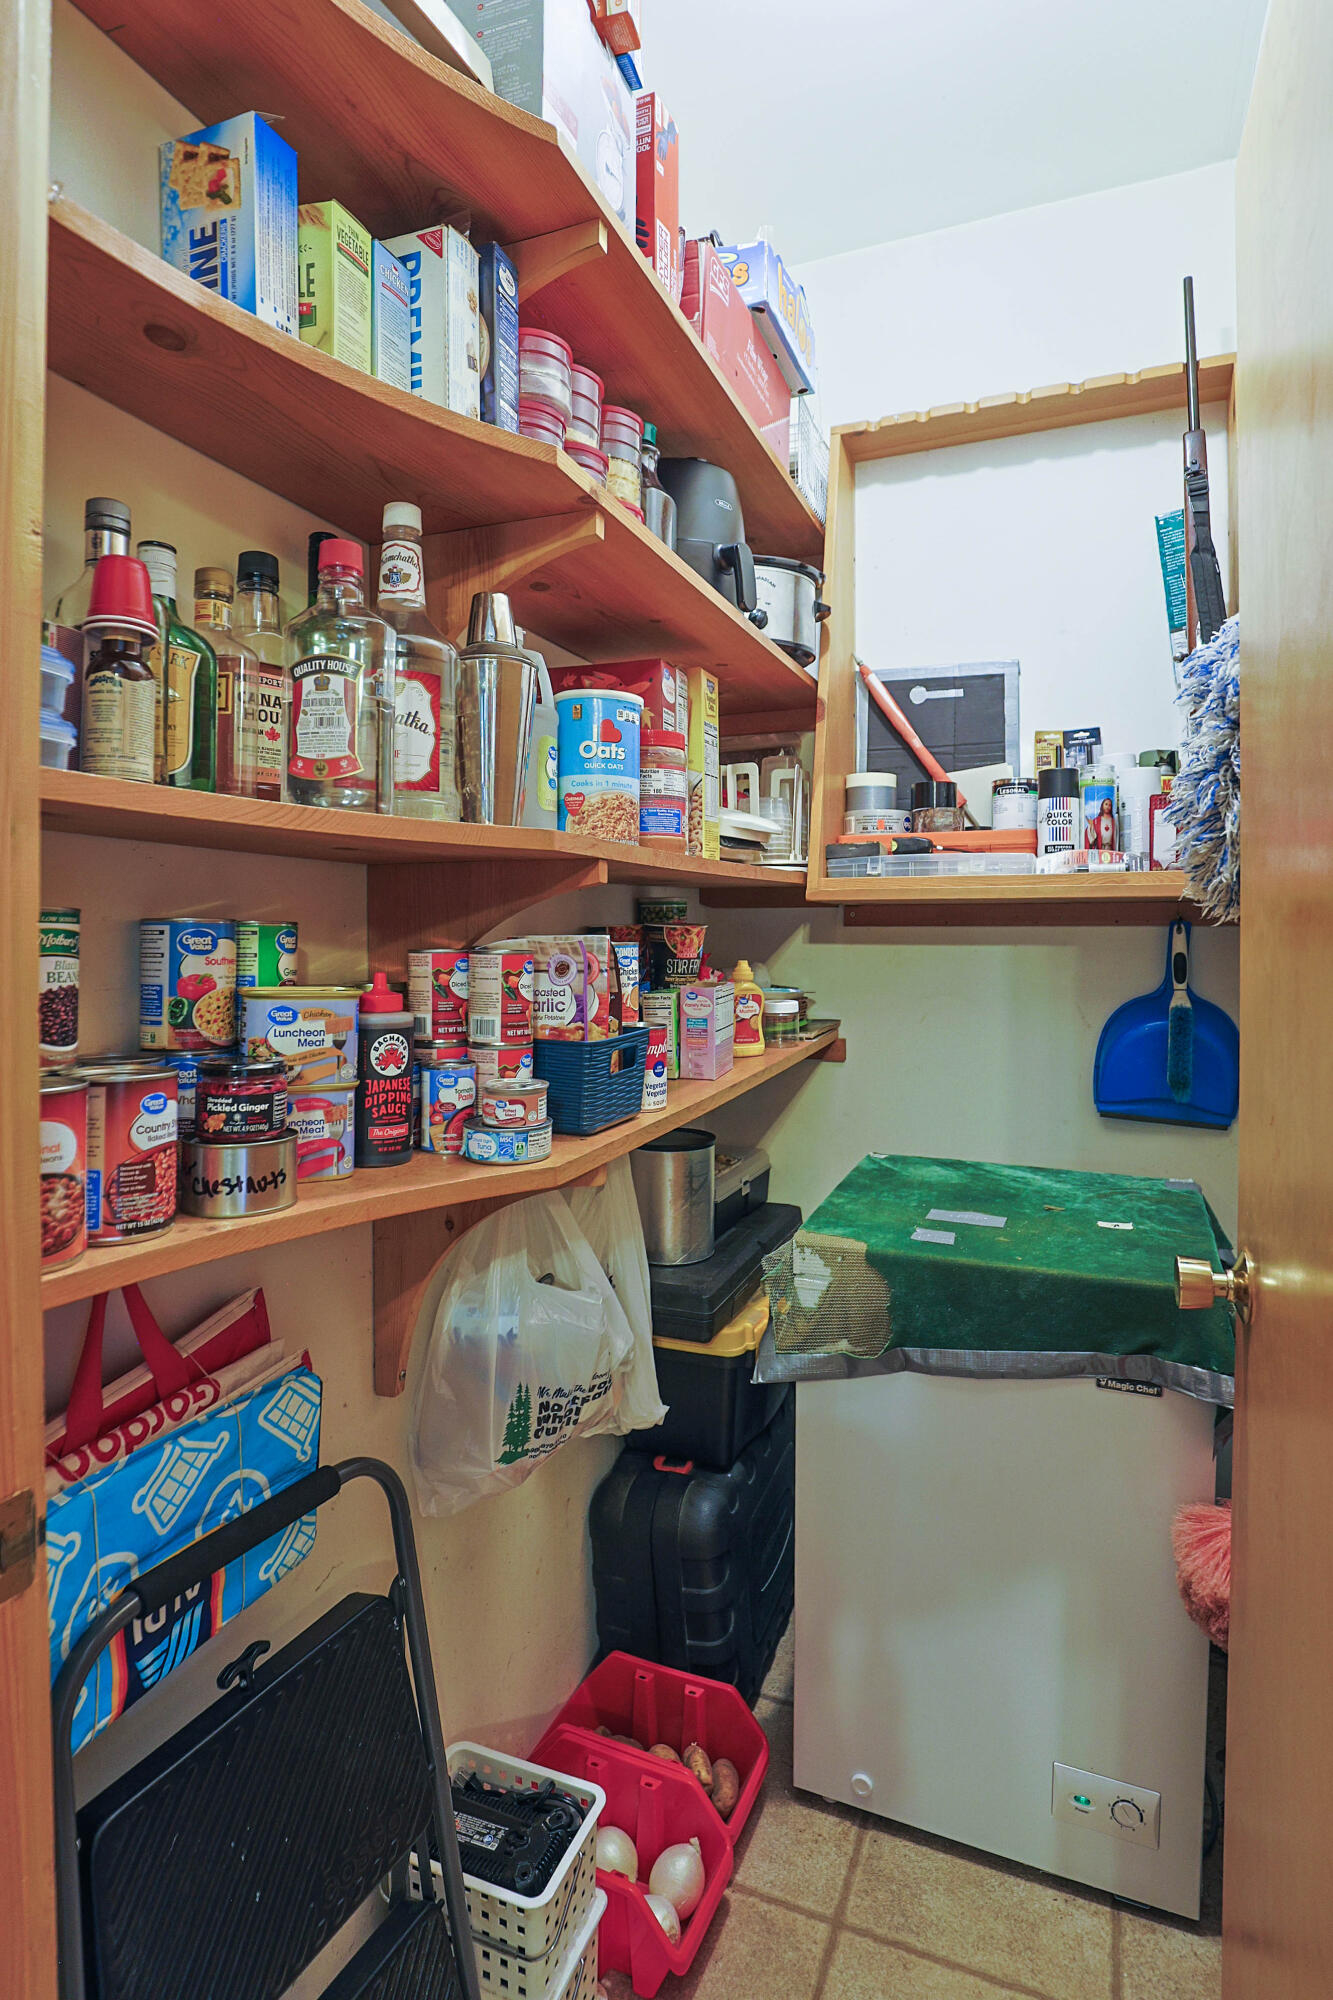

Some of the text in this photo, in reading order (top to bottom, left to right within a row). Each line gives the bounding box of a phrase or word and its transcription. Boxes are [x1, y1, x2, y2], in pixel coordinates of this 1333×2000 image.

[336, 223, 369, 267] VEGETABLE
[380, 263, 409, 297] CHICKEN
[293, 659, 357, 677] QUALITY HOUSE
[579, 740, 627, 761] Oats
[607, 762, 624, 770] OATS
[571, 780, 594, 788] Cooks
[1046, 811, 1073, 819] QUICK
[1046, 818, 1073, 826] COLOR
[182, 934, 213, 945] Great
[271, 1010, 293, 1018] Great
[273, 1028, 326, 1038] Luncheon
[297, 1038, 325, 1047] Meat
[365, 1076, 411, 1095] JAPANESE
[144, 1097, 165, 1107] Great
[365, 1091, 411, 1109] DIPPING
[207, 1103, 270, 1113] Pickled Ginger
[372, 1104, 406, 1119] SAUCE
[136, 1120, 171, 1135] Country
[223, 1125, 232, 1133] NET
[299, 1126, 325, 1134] Meat
[116, 1223, 127, 1231] NET
[127, 1221, 137, 1229] WT
[1107, 1379, 1158, 1395] Magic Chef
